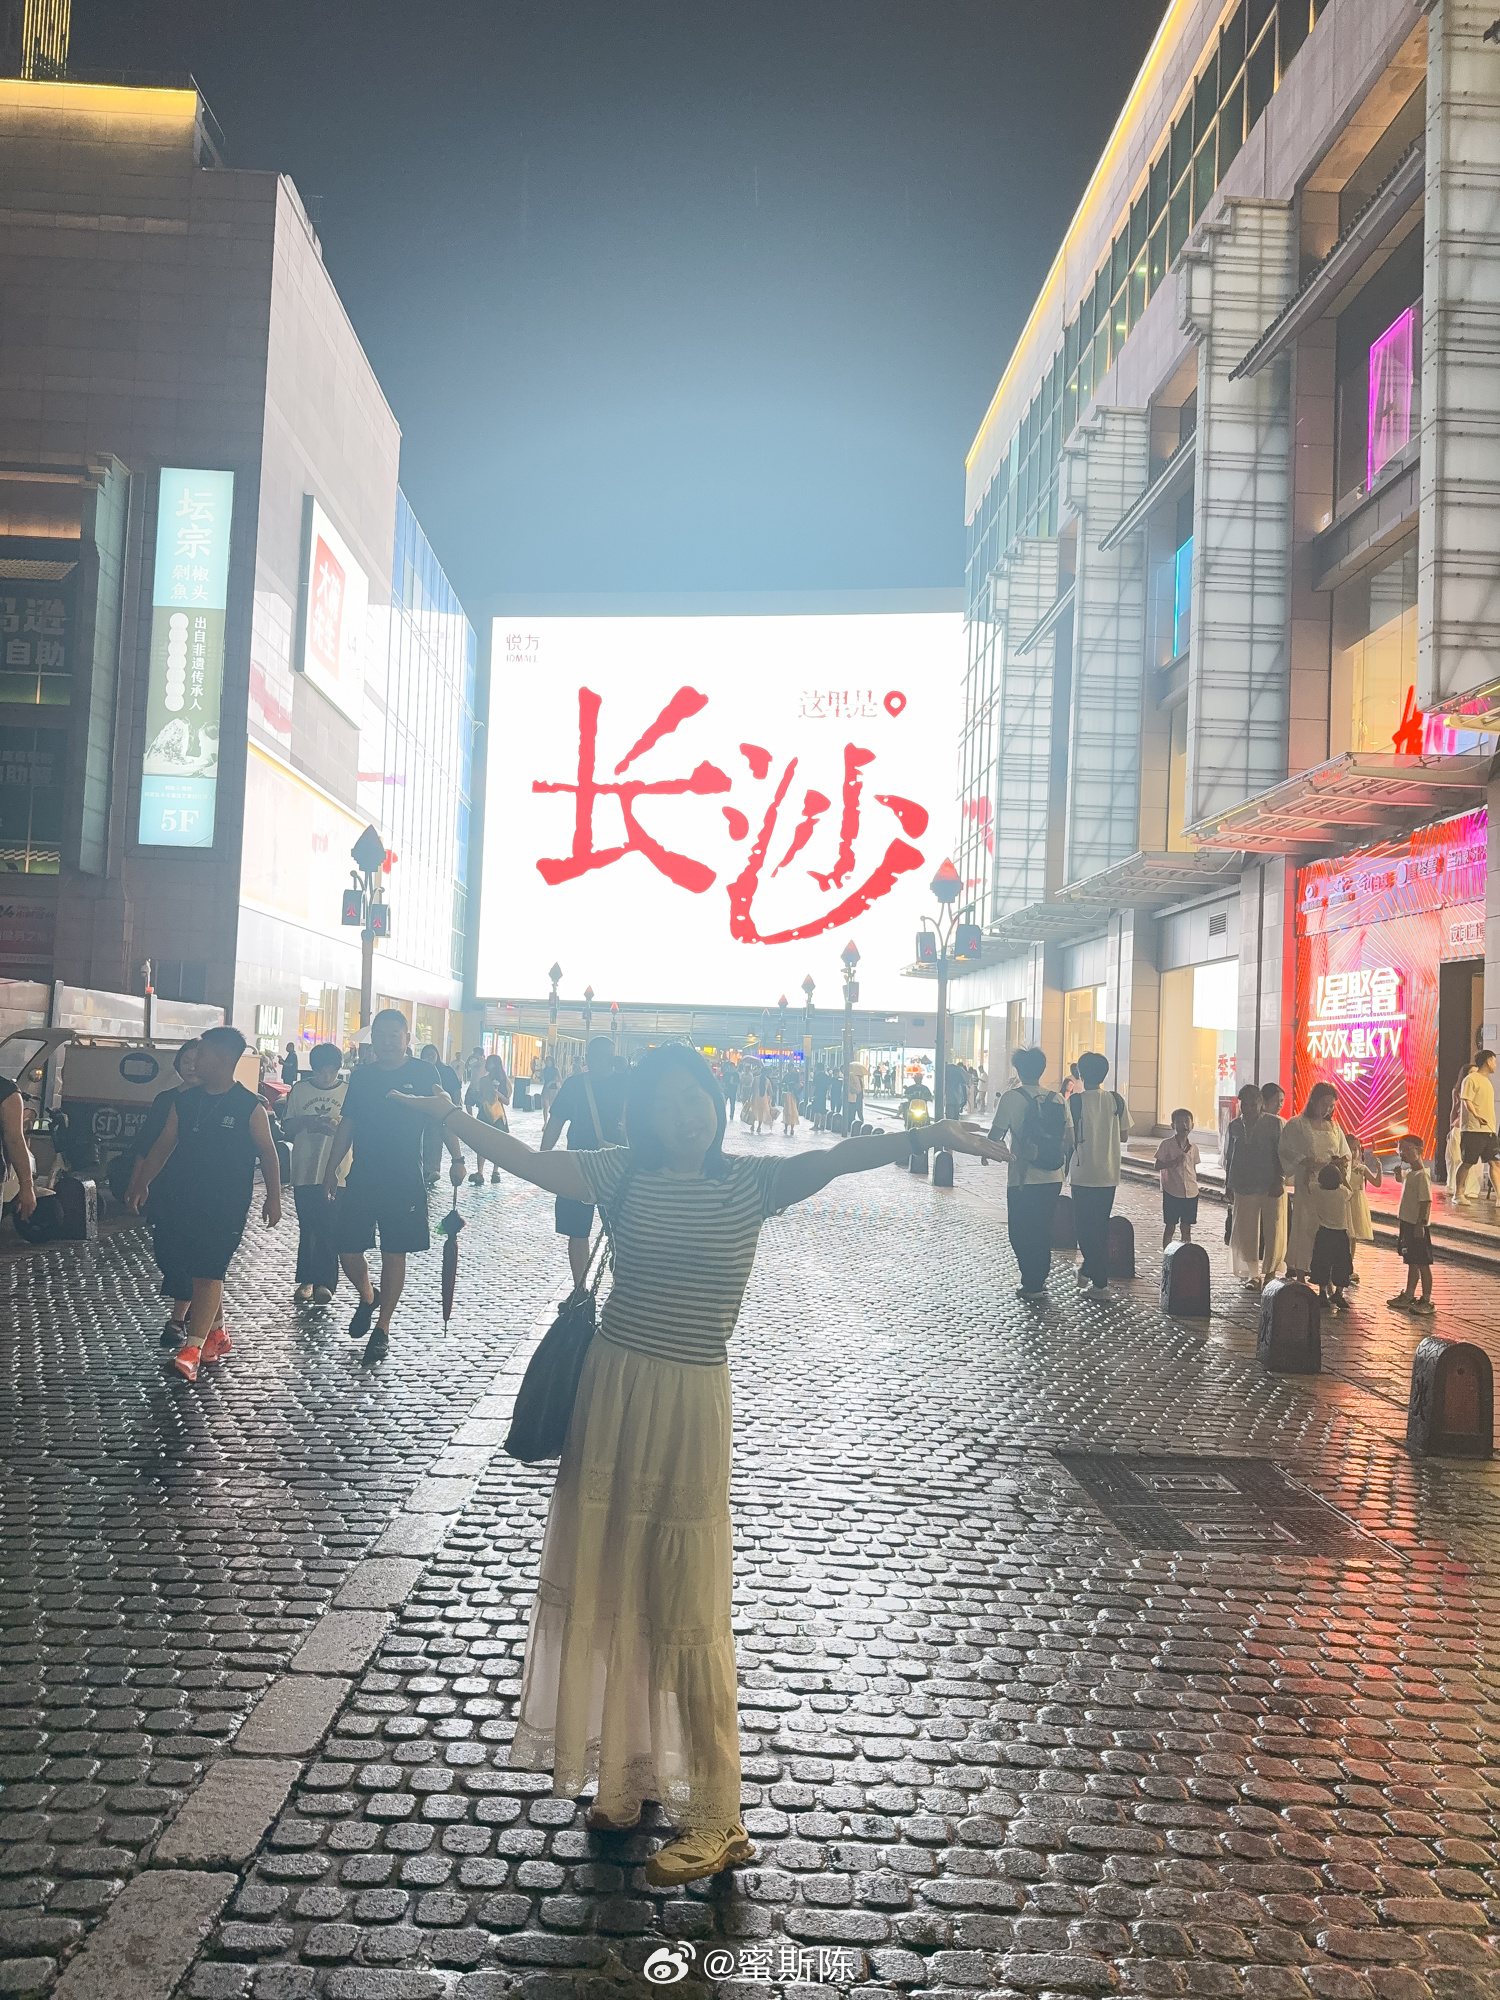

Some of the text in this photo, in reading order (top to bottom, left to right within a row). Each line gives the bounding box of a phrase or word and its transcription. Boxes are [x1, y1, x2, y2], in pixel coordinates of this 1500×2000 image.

[174, 487, 215, 560] 坛宗
[189, 616, 207, 711] 出自非遗传承人
[161, 809, 200, 832] 5F
[532, 685, 929, 945] 长沙
[258, 1004, 284, 1037] MUJI
